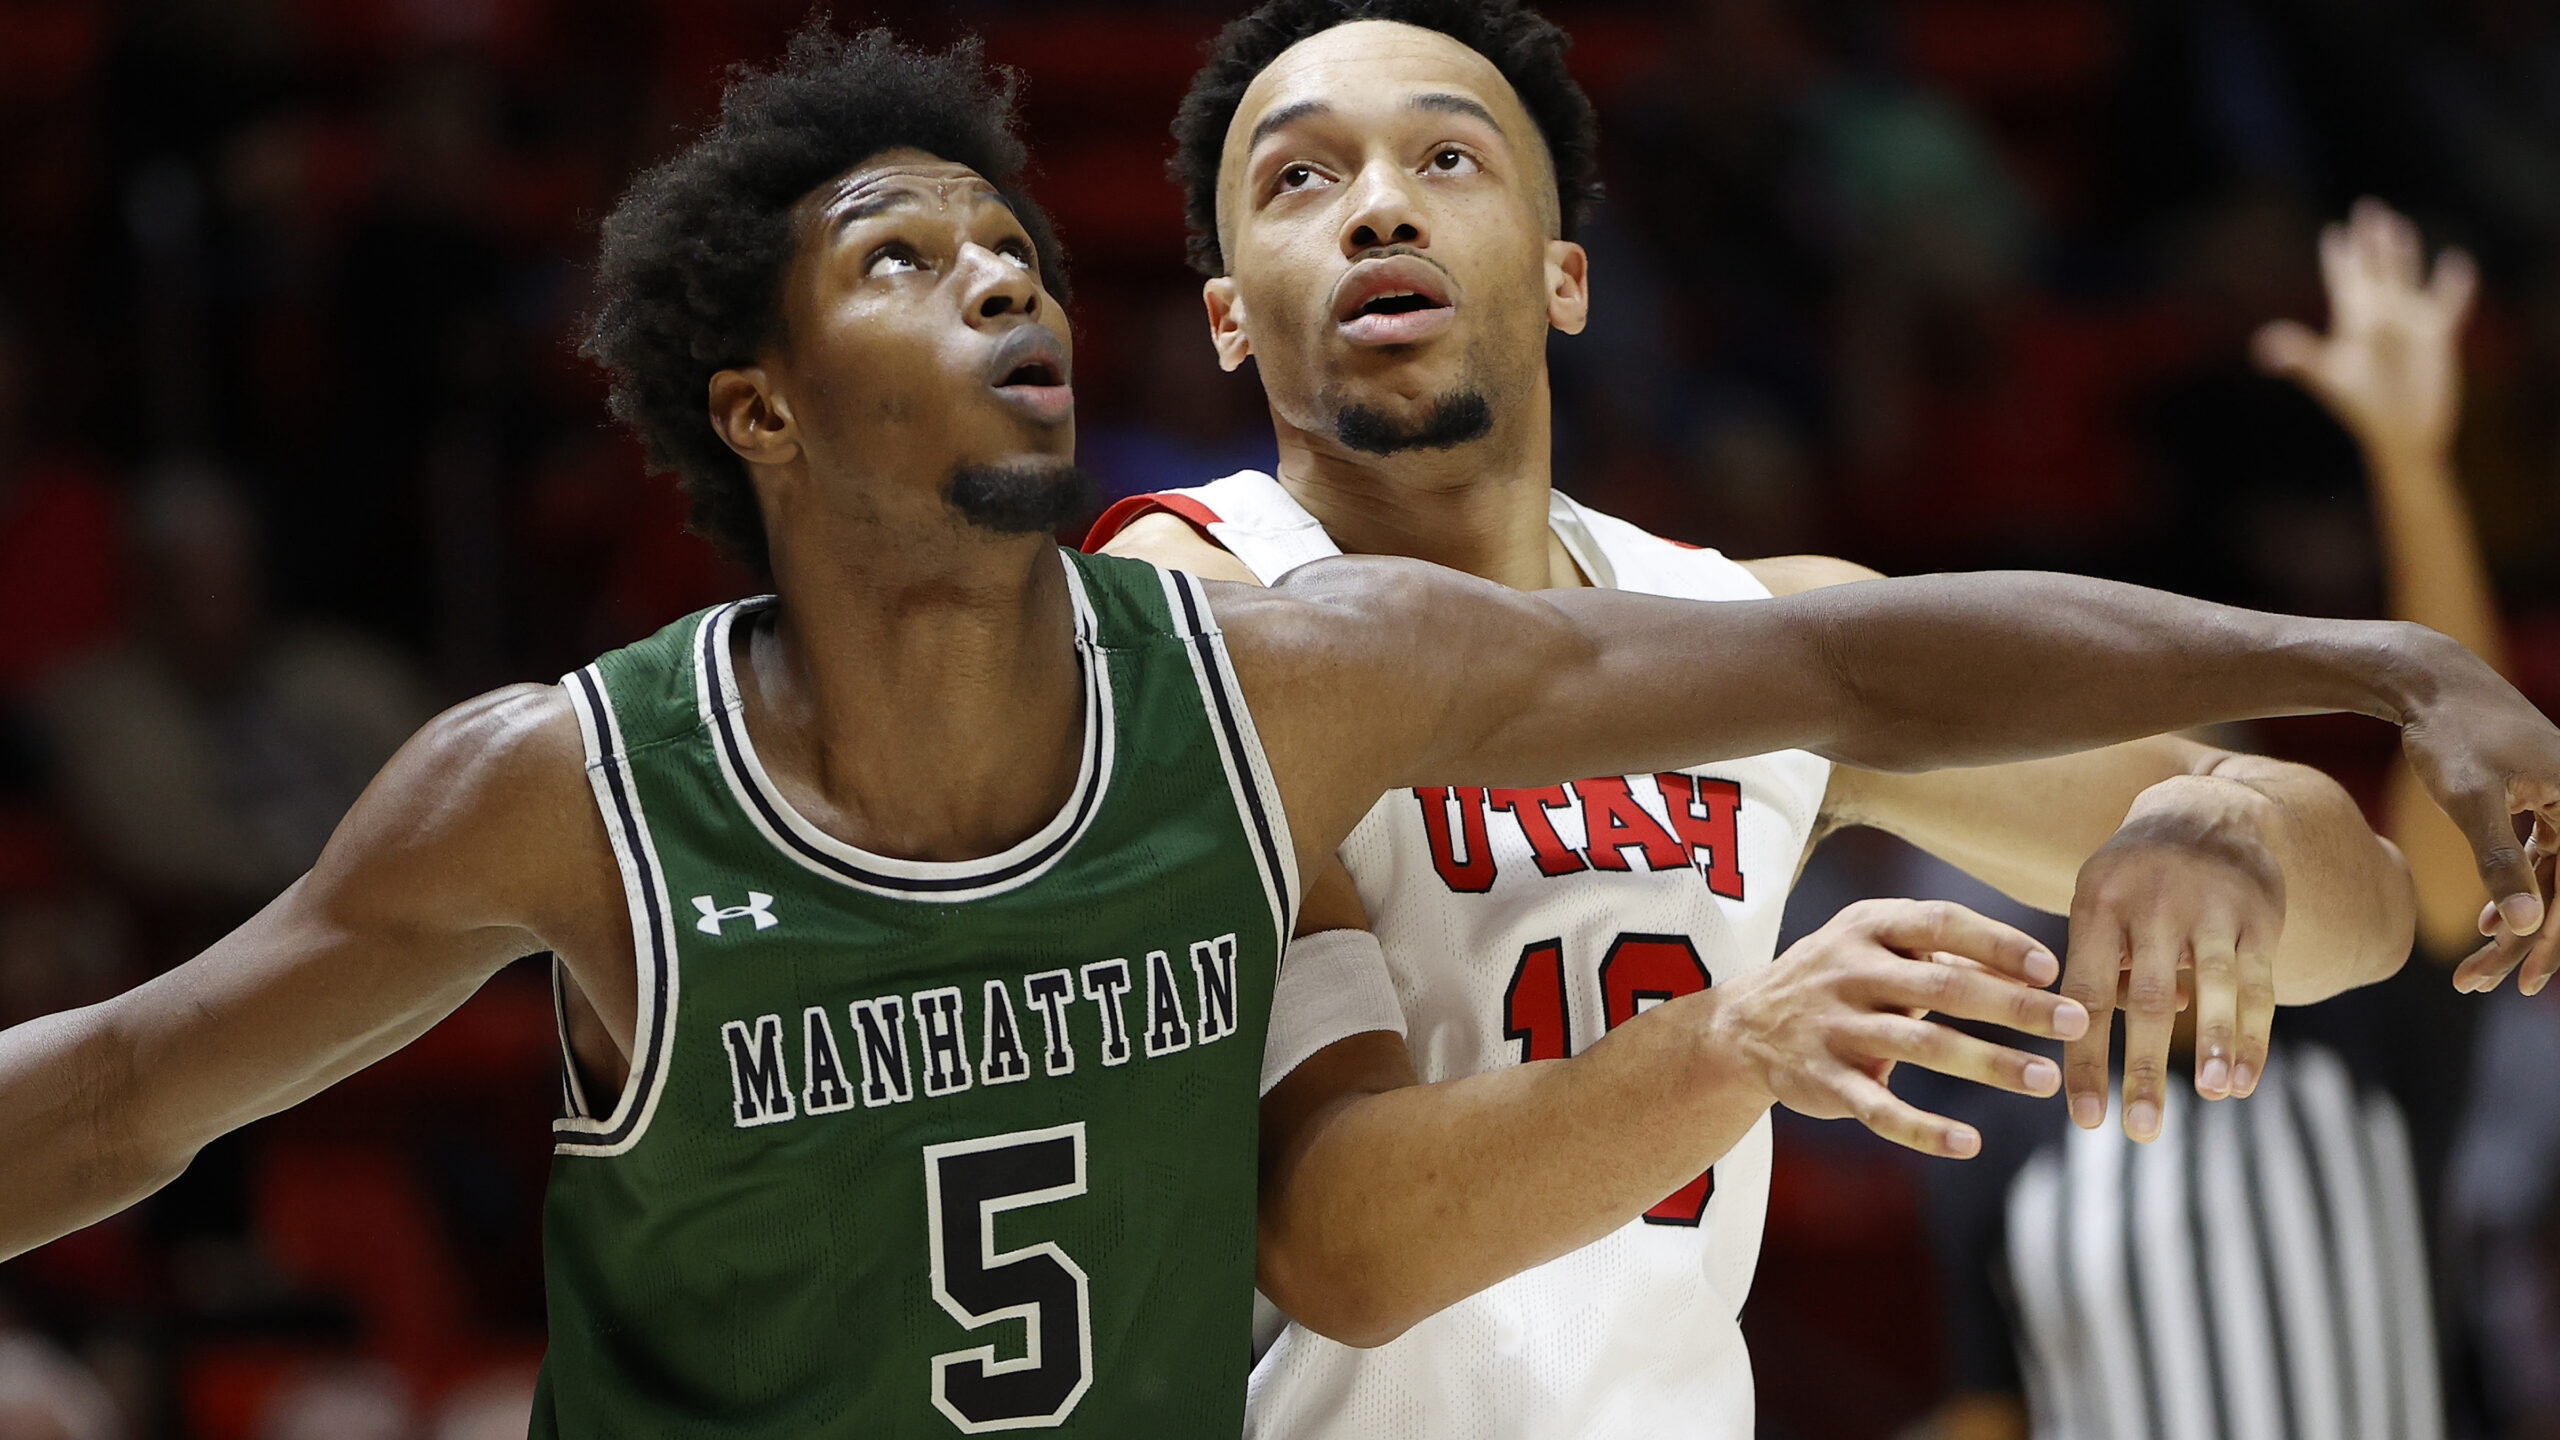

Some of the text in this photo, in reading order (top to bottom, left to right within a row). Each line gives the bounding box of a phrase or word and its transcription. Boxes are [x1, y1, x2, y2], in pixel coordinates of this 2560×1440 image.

[1413, 771, 1744, 902] UTAH
[722, 933, 1237, 1127] MANHATTAN
[923, 1121, 1093, 1434] 5
